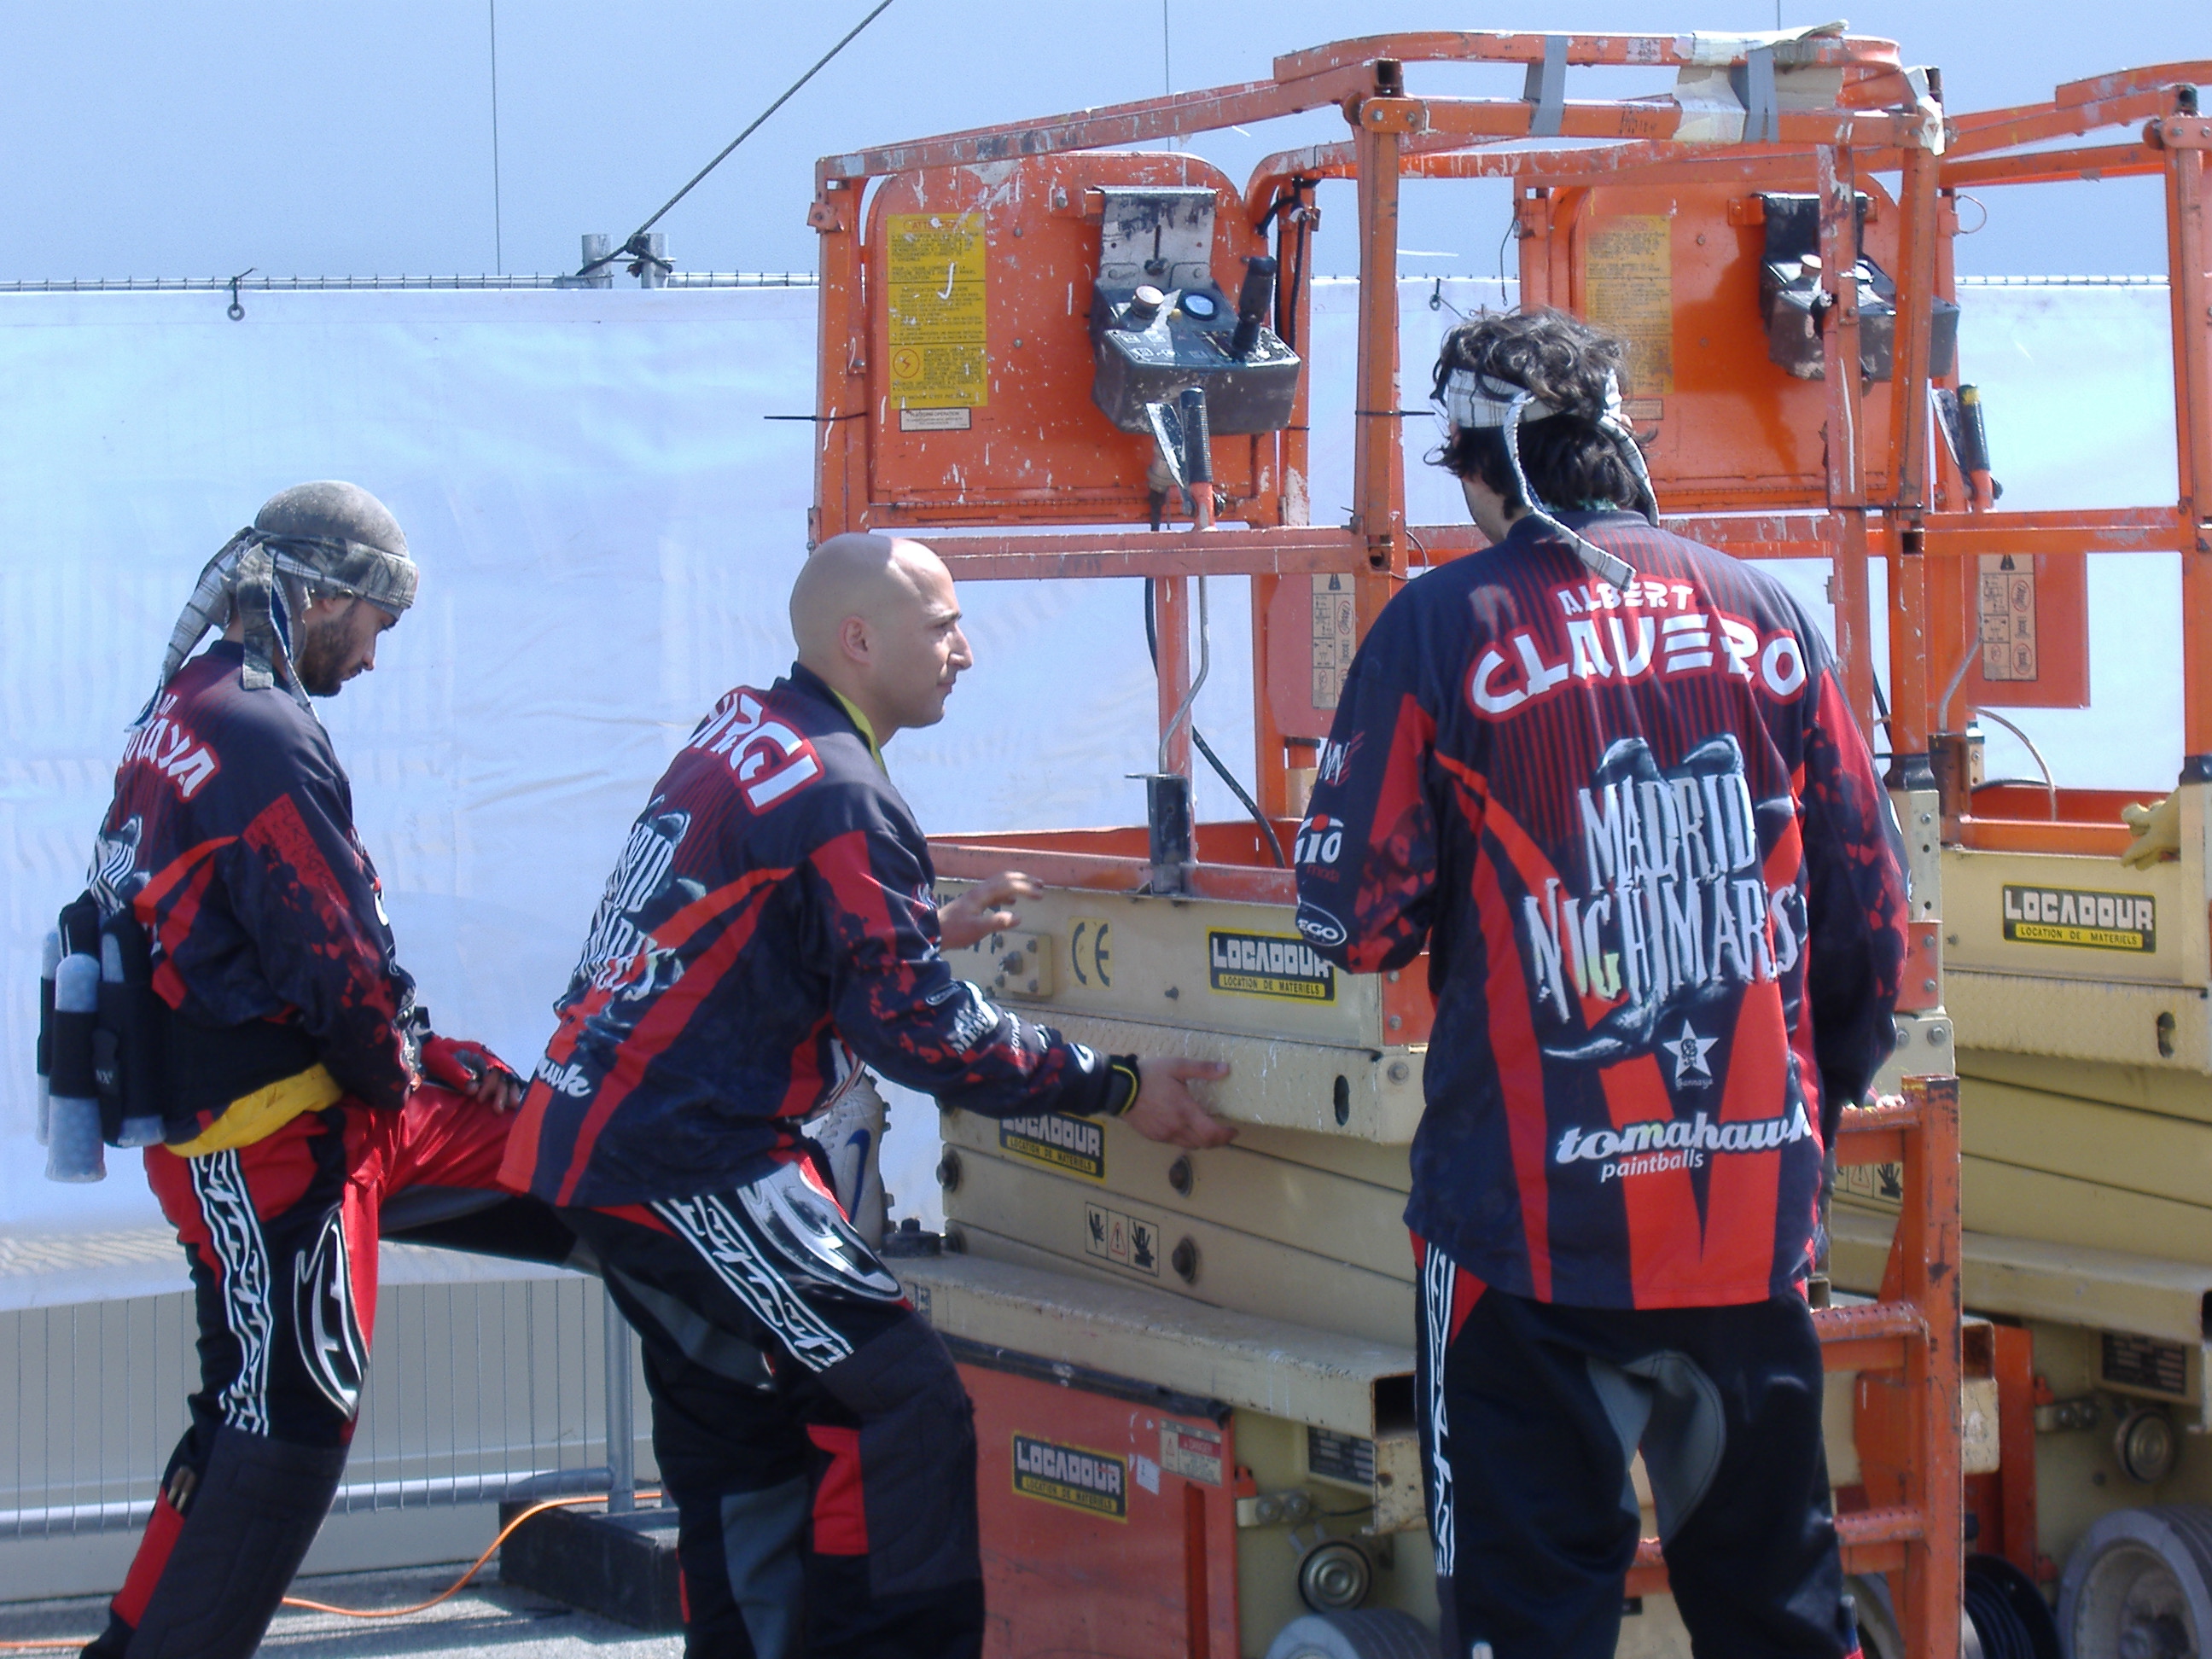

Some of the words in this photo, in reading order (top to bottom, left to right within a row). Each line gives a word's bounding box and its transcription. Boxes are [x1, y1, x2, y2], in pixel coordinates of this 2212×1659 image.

[1557, 580, 1694, 616] ALBERT
[1578, 773, 1757, 895] MADRID
[2005, 889, 2154, 931] LOCADOUR
[2020, 926, 2063, 939] LOCATION
[2069, 932, 2081, 940] DE
[2091, 932, 2137, 945] MATERIELS
[1223, 975, 1258, 990] LOCATION
[1263, 980, 1274, 991] DE
[1279, 982, 1320, 995] MATERIELS
[1600, 1148, 1704, 1183] paintballs
[1016, 1441, 1121, 1495] LOCADOUR
